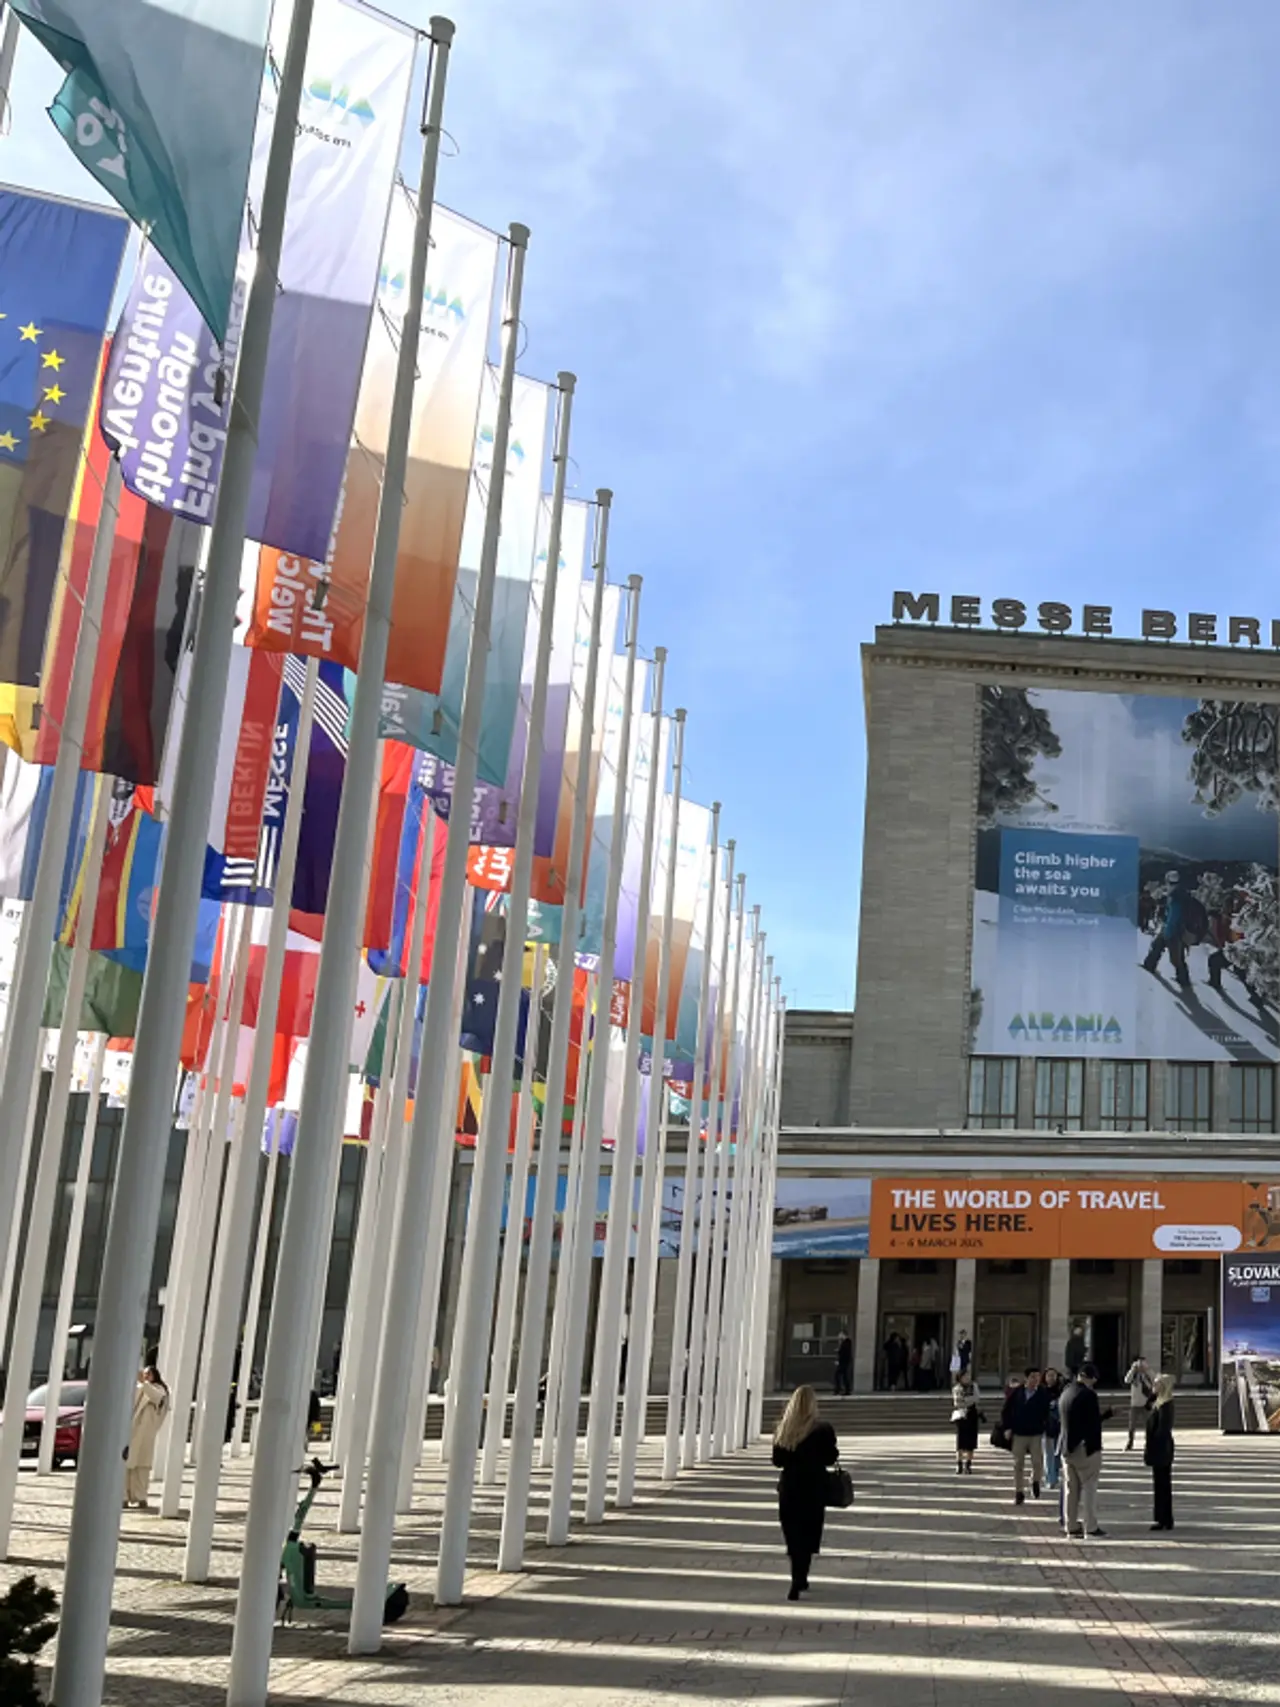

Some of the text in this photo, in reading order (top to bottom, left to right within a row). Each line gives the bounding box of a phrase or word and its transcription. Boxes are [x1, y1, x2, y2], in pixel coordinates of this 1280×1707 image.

[892, 590, 1113, 635] MESSE
[1015, 851, 1117, 870] Climb higher
[1014, 866, 1072, 881] the sea
[1015, 882, 1101, 898] awaits you
[1007, 1012, 1121, 1033] ALBANIA
[891, 1189, 1166, 1210] THE WORLD OF TRAVEL
[890, 1213, 1034, 1233] LIVES HERE.
[917, 1238, 957, 1248] MARCH
[959, 1238, 984, 1249] 2025
